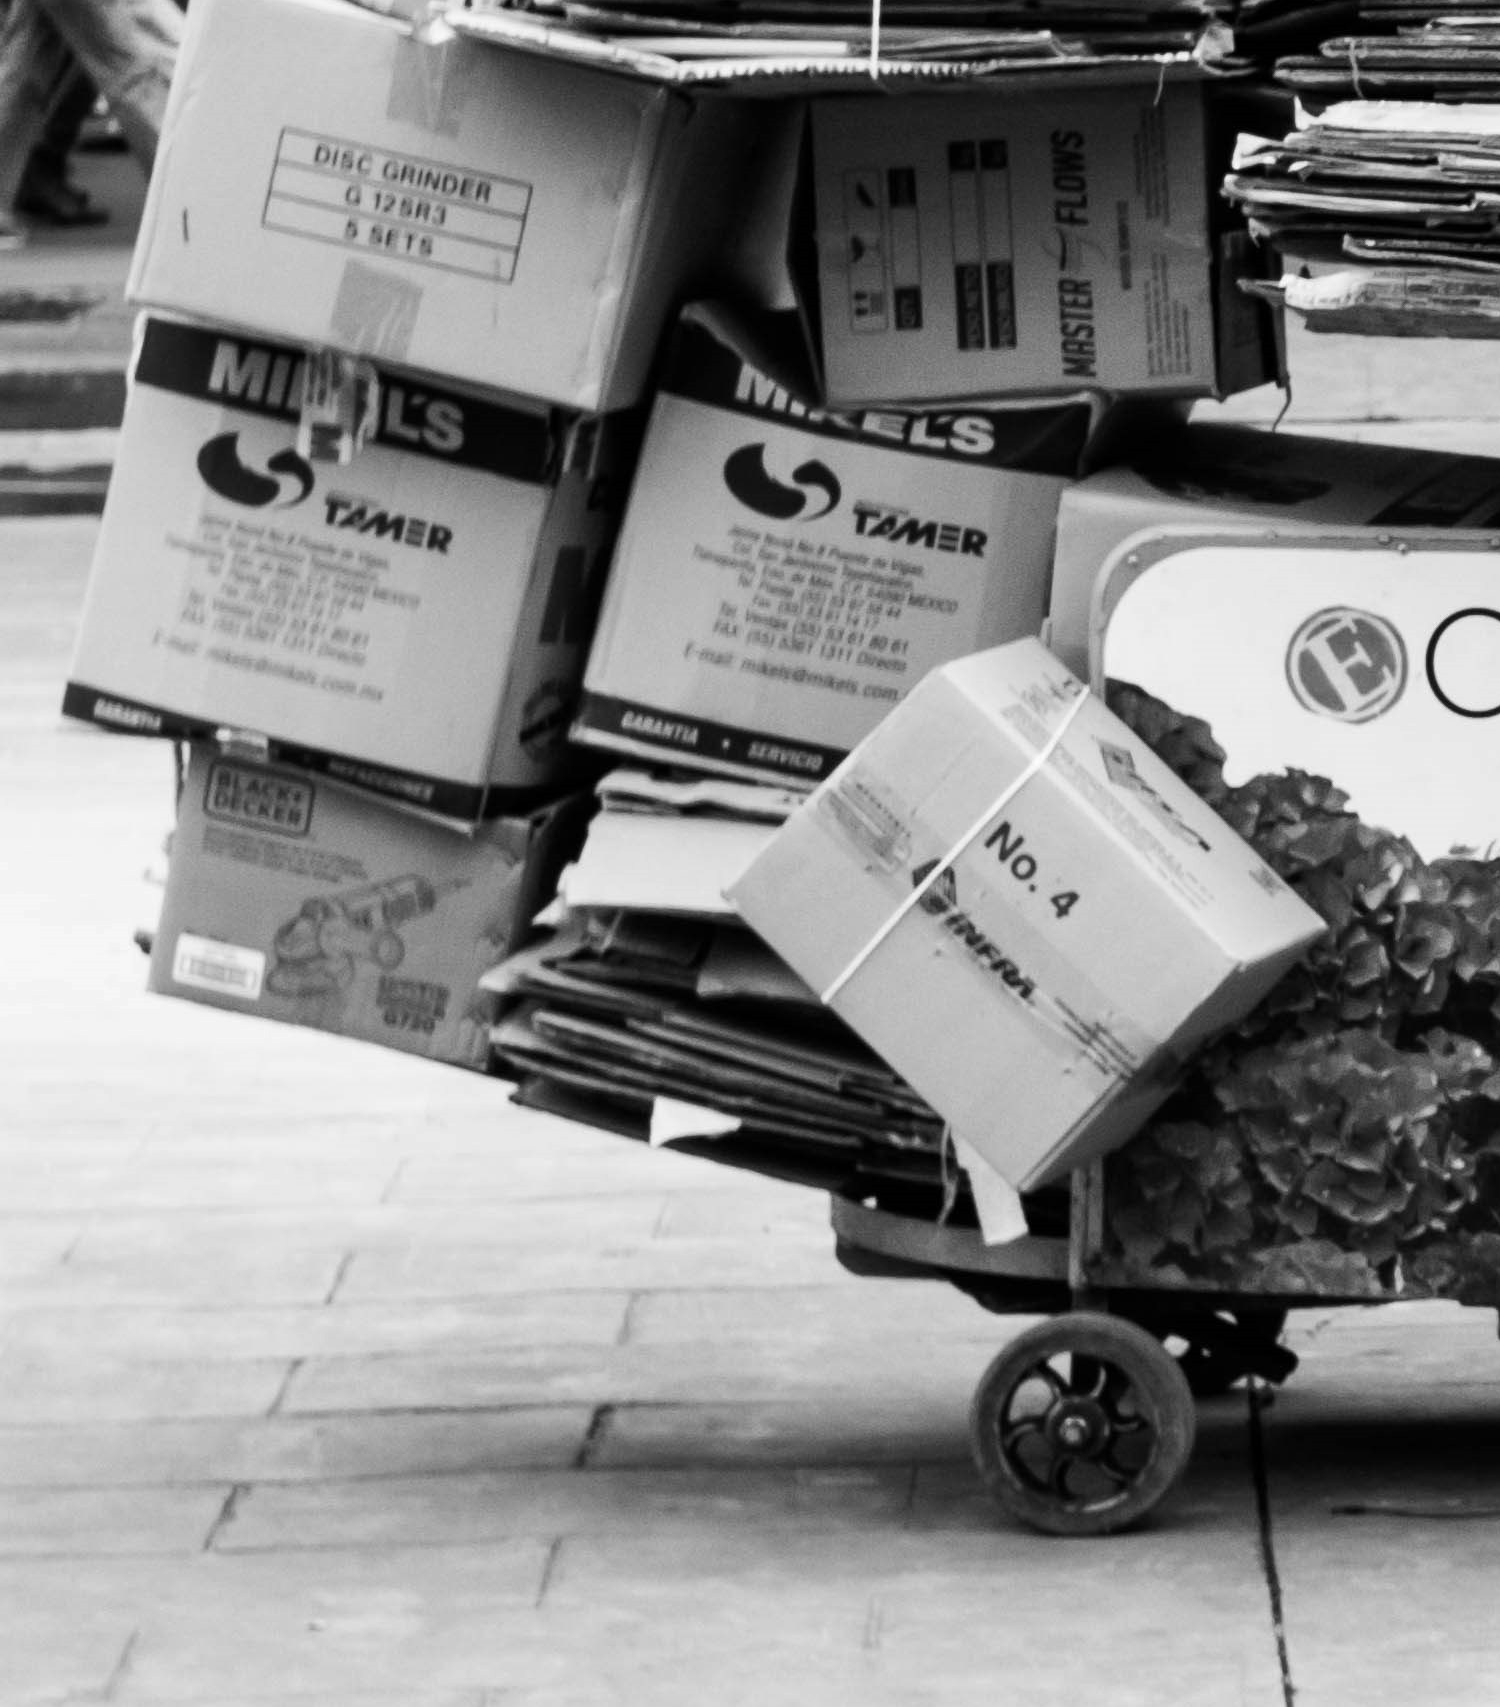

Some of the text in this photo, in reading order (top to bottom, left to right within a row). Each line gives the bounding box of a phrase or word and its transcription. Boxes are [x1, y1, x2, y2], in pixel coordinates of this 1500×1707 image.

[380, 158, 493, 203] GRINDER
[368, 223, 435, 257] SETS
[1050, 129, 1098, 379] MASTER FLOWS
[207, 342, 466, 451] MIL'S
[320, 496, 455, 554] TAMER
[853, 506, 989, 557] TAMER
[983, 819, 1082, 922] No. 4
